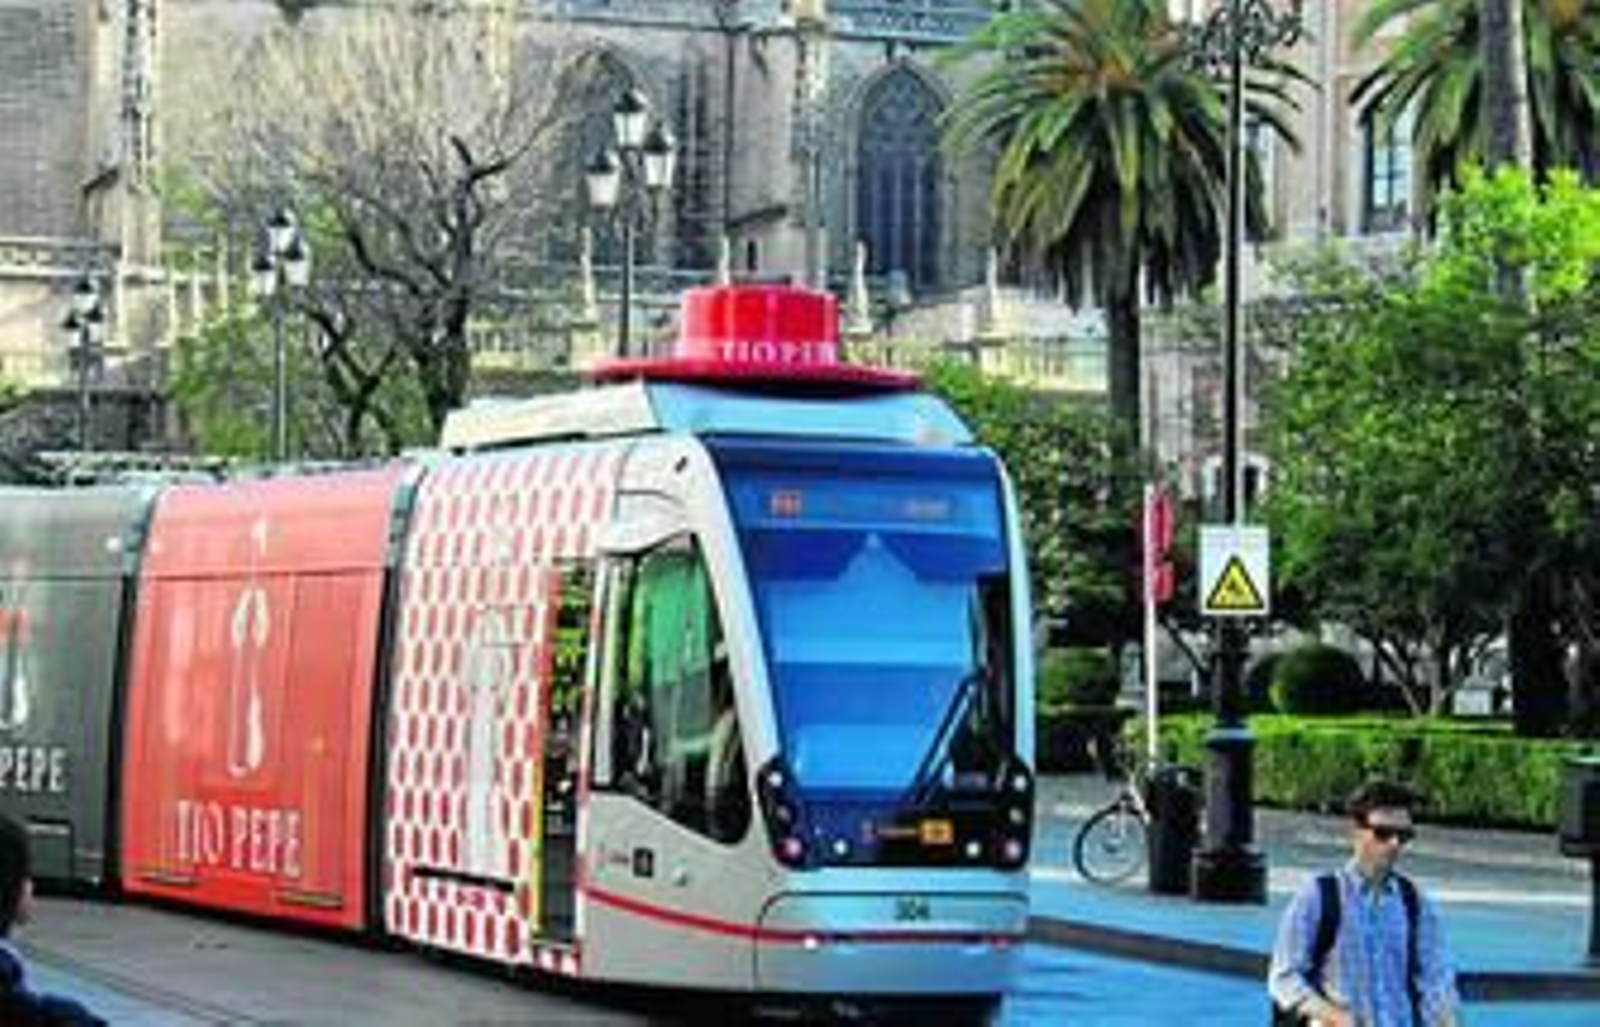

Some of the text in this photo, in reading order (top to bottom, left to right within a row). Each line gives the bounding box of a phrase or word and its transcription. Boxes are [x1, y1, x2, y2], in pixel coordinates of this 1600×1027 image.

[0, 747, 67, 792] PEPE
[176, 799, 301, 878] TIO PEPE
